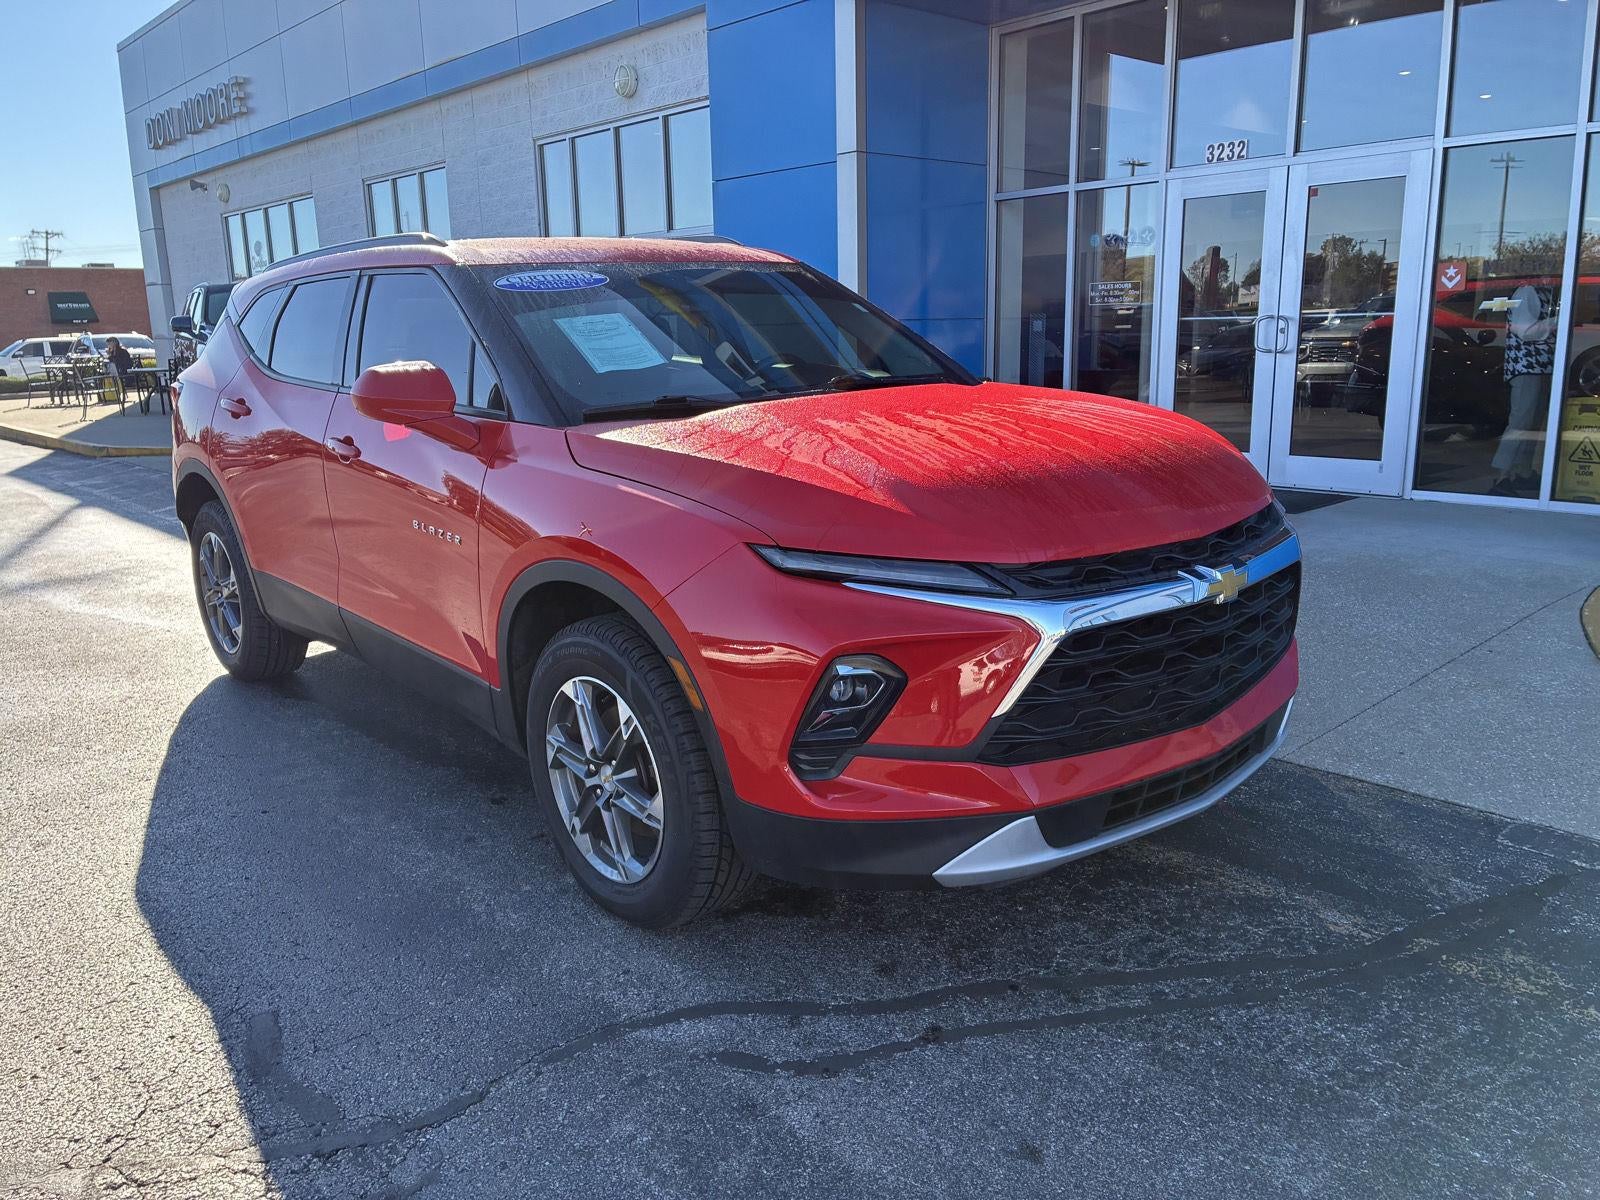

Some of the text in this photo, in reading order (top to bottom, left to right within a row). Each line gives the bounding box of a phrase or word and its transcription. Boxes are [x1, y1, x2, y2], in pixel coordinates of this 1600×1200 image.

[145, 76, 248, 149] DON MOORE
[1206, 140, 1246, 163] 3232
[506, 273, 594, 284] CERTIFIED
[412, 519, 462, 546] BLAZER
